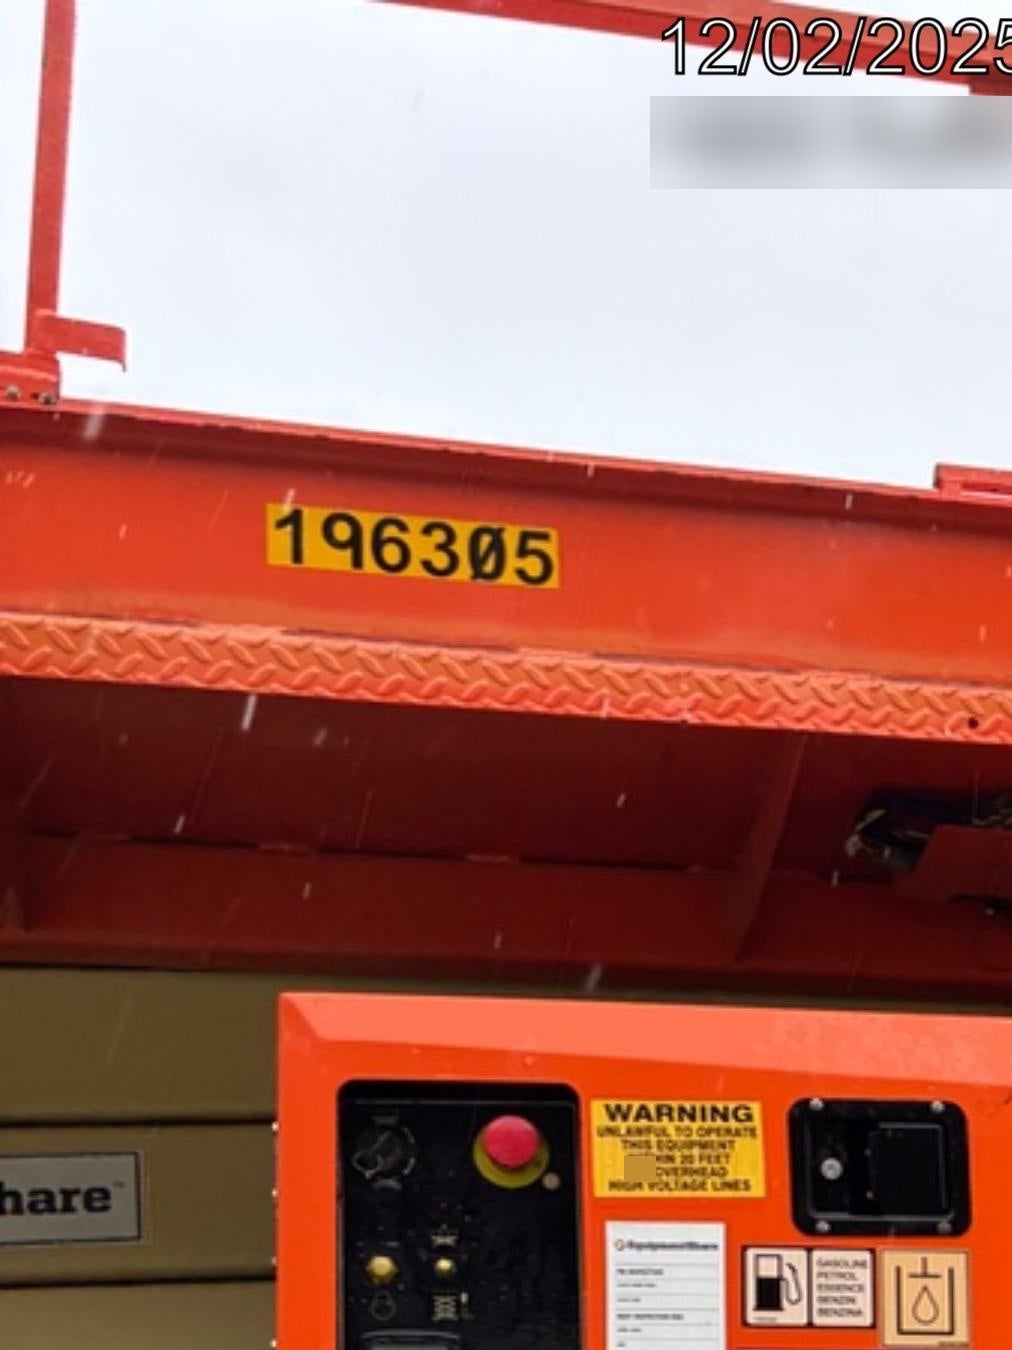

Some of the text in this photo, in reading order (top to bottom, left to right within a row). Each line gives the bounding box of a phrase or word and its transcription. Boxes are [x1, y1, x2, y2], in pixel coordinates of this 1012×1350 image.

[273, 508, 555, 586] 196305
[604, 1104, 753, 1122] WARNING
[597, 1125, 757, 1138] UNLAWFUL TO OPERATE
[621, 1139, 736, 1151] THIS EQUIPMENT
[699, 1153, 730, 1164] FEET
[656, 1166, 728, 1177] OVERHEAD
[608, 1180, 751, 1192] HIGH VOLTAGE LINES
[816, 1259, 868, 1269] GASOLINE
[816, 1271, 858, 1281] PETROL
